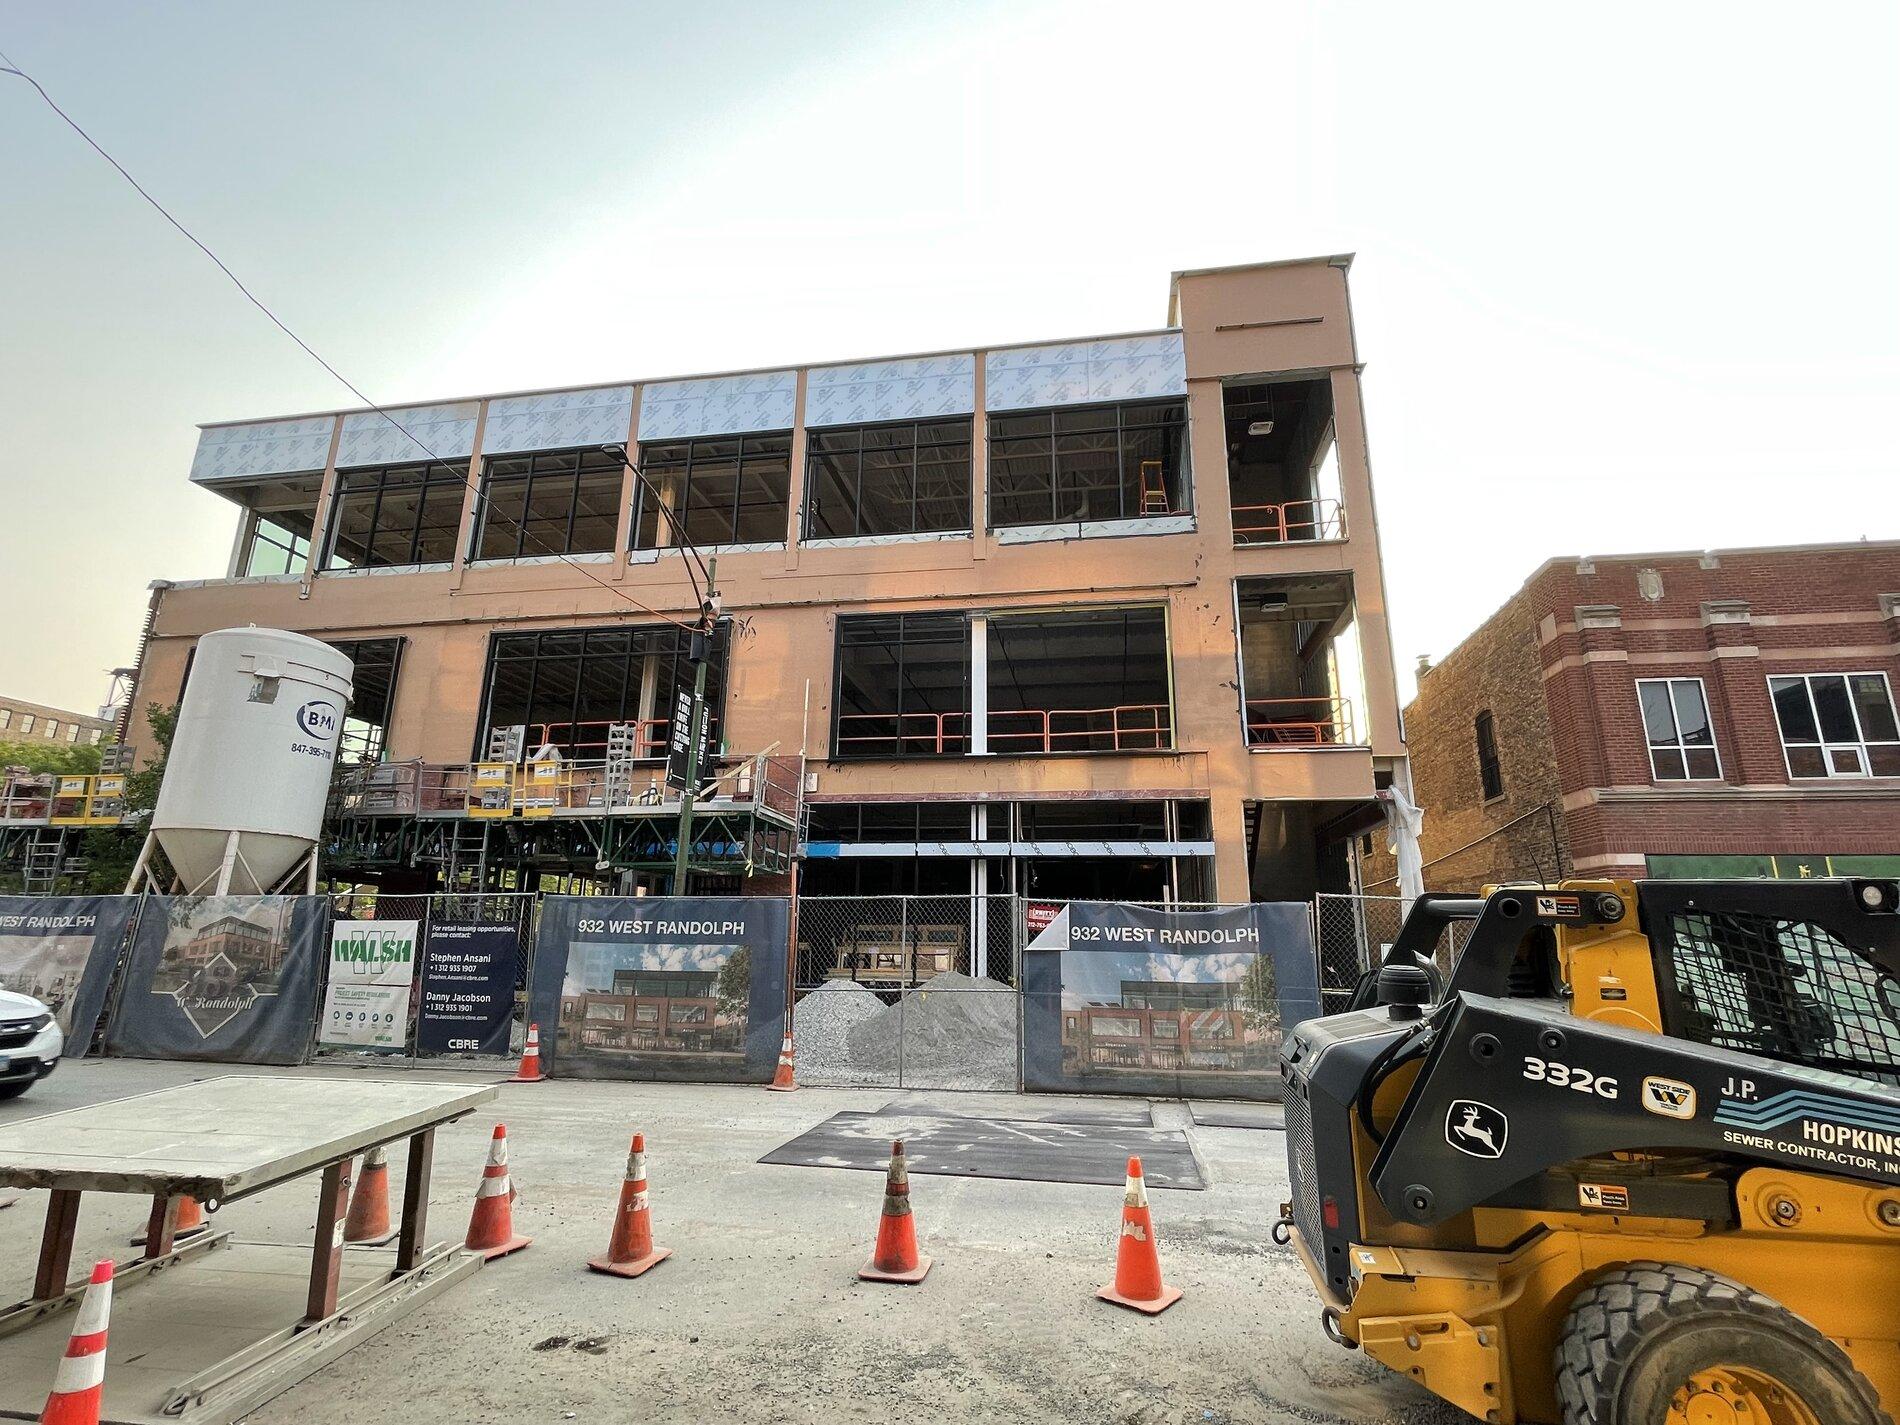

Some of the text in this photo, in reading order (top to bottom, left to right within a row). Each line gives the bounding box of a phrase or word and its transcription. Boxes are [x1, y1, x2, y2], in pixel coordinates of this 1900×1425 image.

[27, 915, 96, 928] RANDOLPH
[578, 919, 745, 935] 932 WEST RANDOLPH
[1071, 926, 1259, 944] 932 WEST RANDOLPH
[334, 939, 412, 963] WALSH
[430, 953, 491, 963] Stephen Ansani
[438, 964, 448, 972] 312
[449, 964, 460, 972] 935
[195, 997, 253, 1009] Randolph
[426, 991, 491, 1003] Danny Jacobson
[434, 1004, 444, 1012] 312
[445, 1004, 457, 1012] 935
[448, 1039, 479, 1050] CBRE
[1522, 1056, 1618, 1100] 332G
[1648, 1081, 1671, 1091] WEST
[1720, 1077, 1758, 1100] J.P.
[1723, 1131, 1900, 1174] SEWER CONTRACTOR, IN
